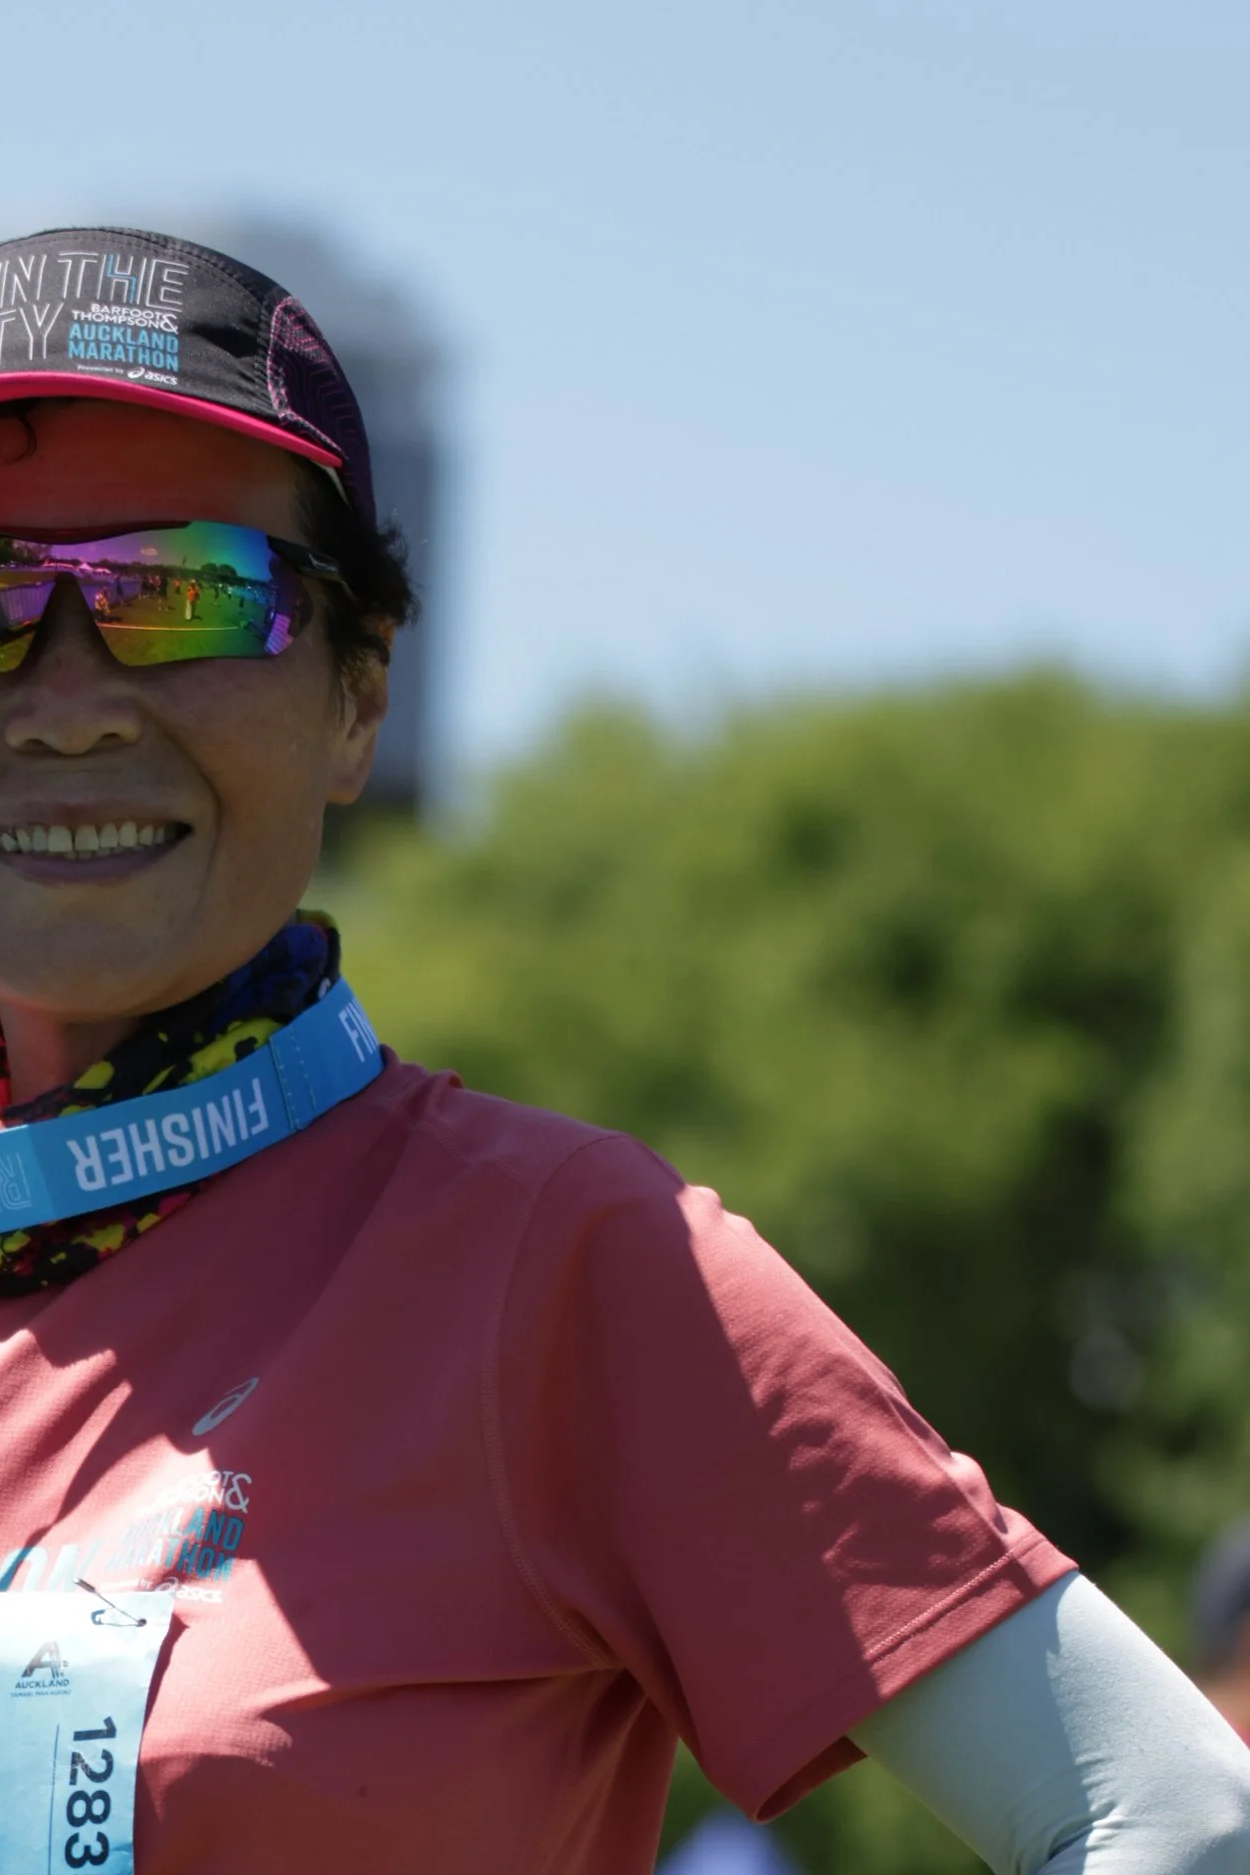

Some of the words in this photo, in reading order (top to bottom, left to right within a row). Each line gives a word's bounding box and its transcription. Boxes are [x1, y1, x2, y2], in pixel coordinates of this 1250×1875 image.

[56, 252, 190, 312] THE
[71, 310, 160, 330] THOMPSON
[69, 322, 179, 354] AUCKLAND
[68, 341, 180, 373] MARATHON
[66, 1077, 270, 1193] FINISHER
[14, 1678, 71, 1690] AUCKLAND
